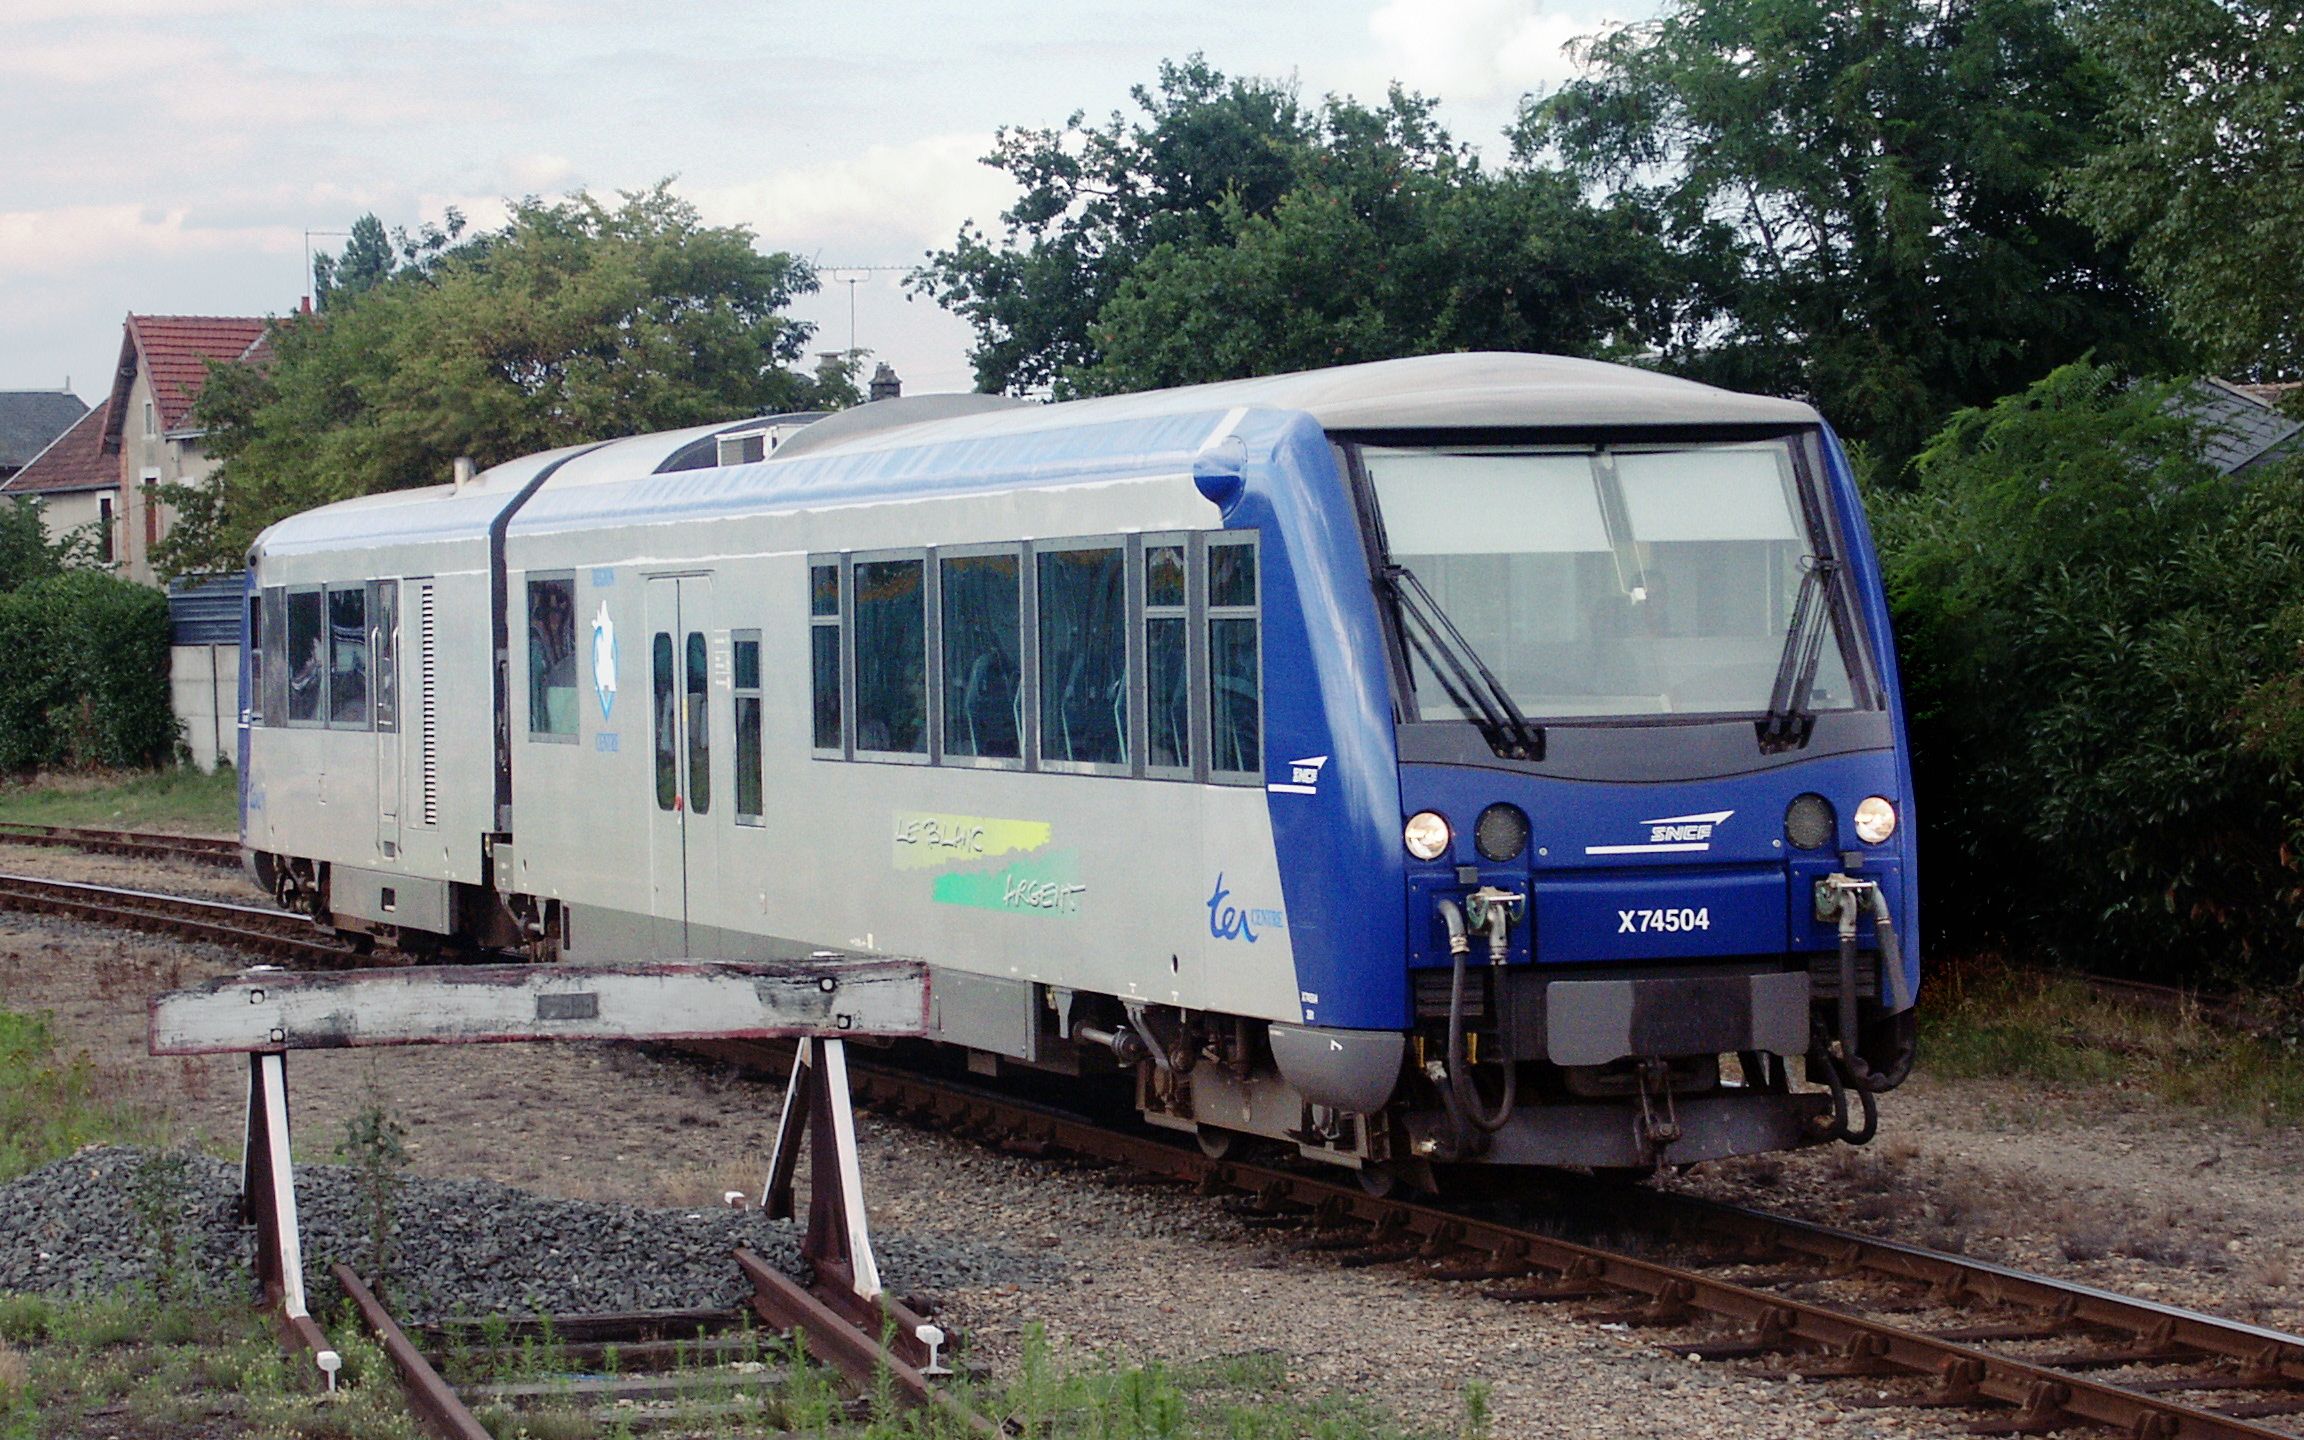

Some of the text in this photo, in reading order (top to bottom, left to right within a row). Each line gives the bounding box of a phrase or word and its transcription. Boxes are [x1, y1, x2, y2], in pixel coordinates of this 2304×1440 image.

[1650, 824, 1712, 842] SNCF
[1207, 871, 1258, 943] ter
[1617, 907, 1711, 934] X74504
